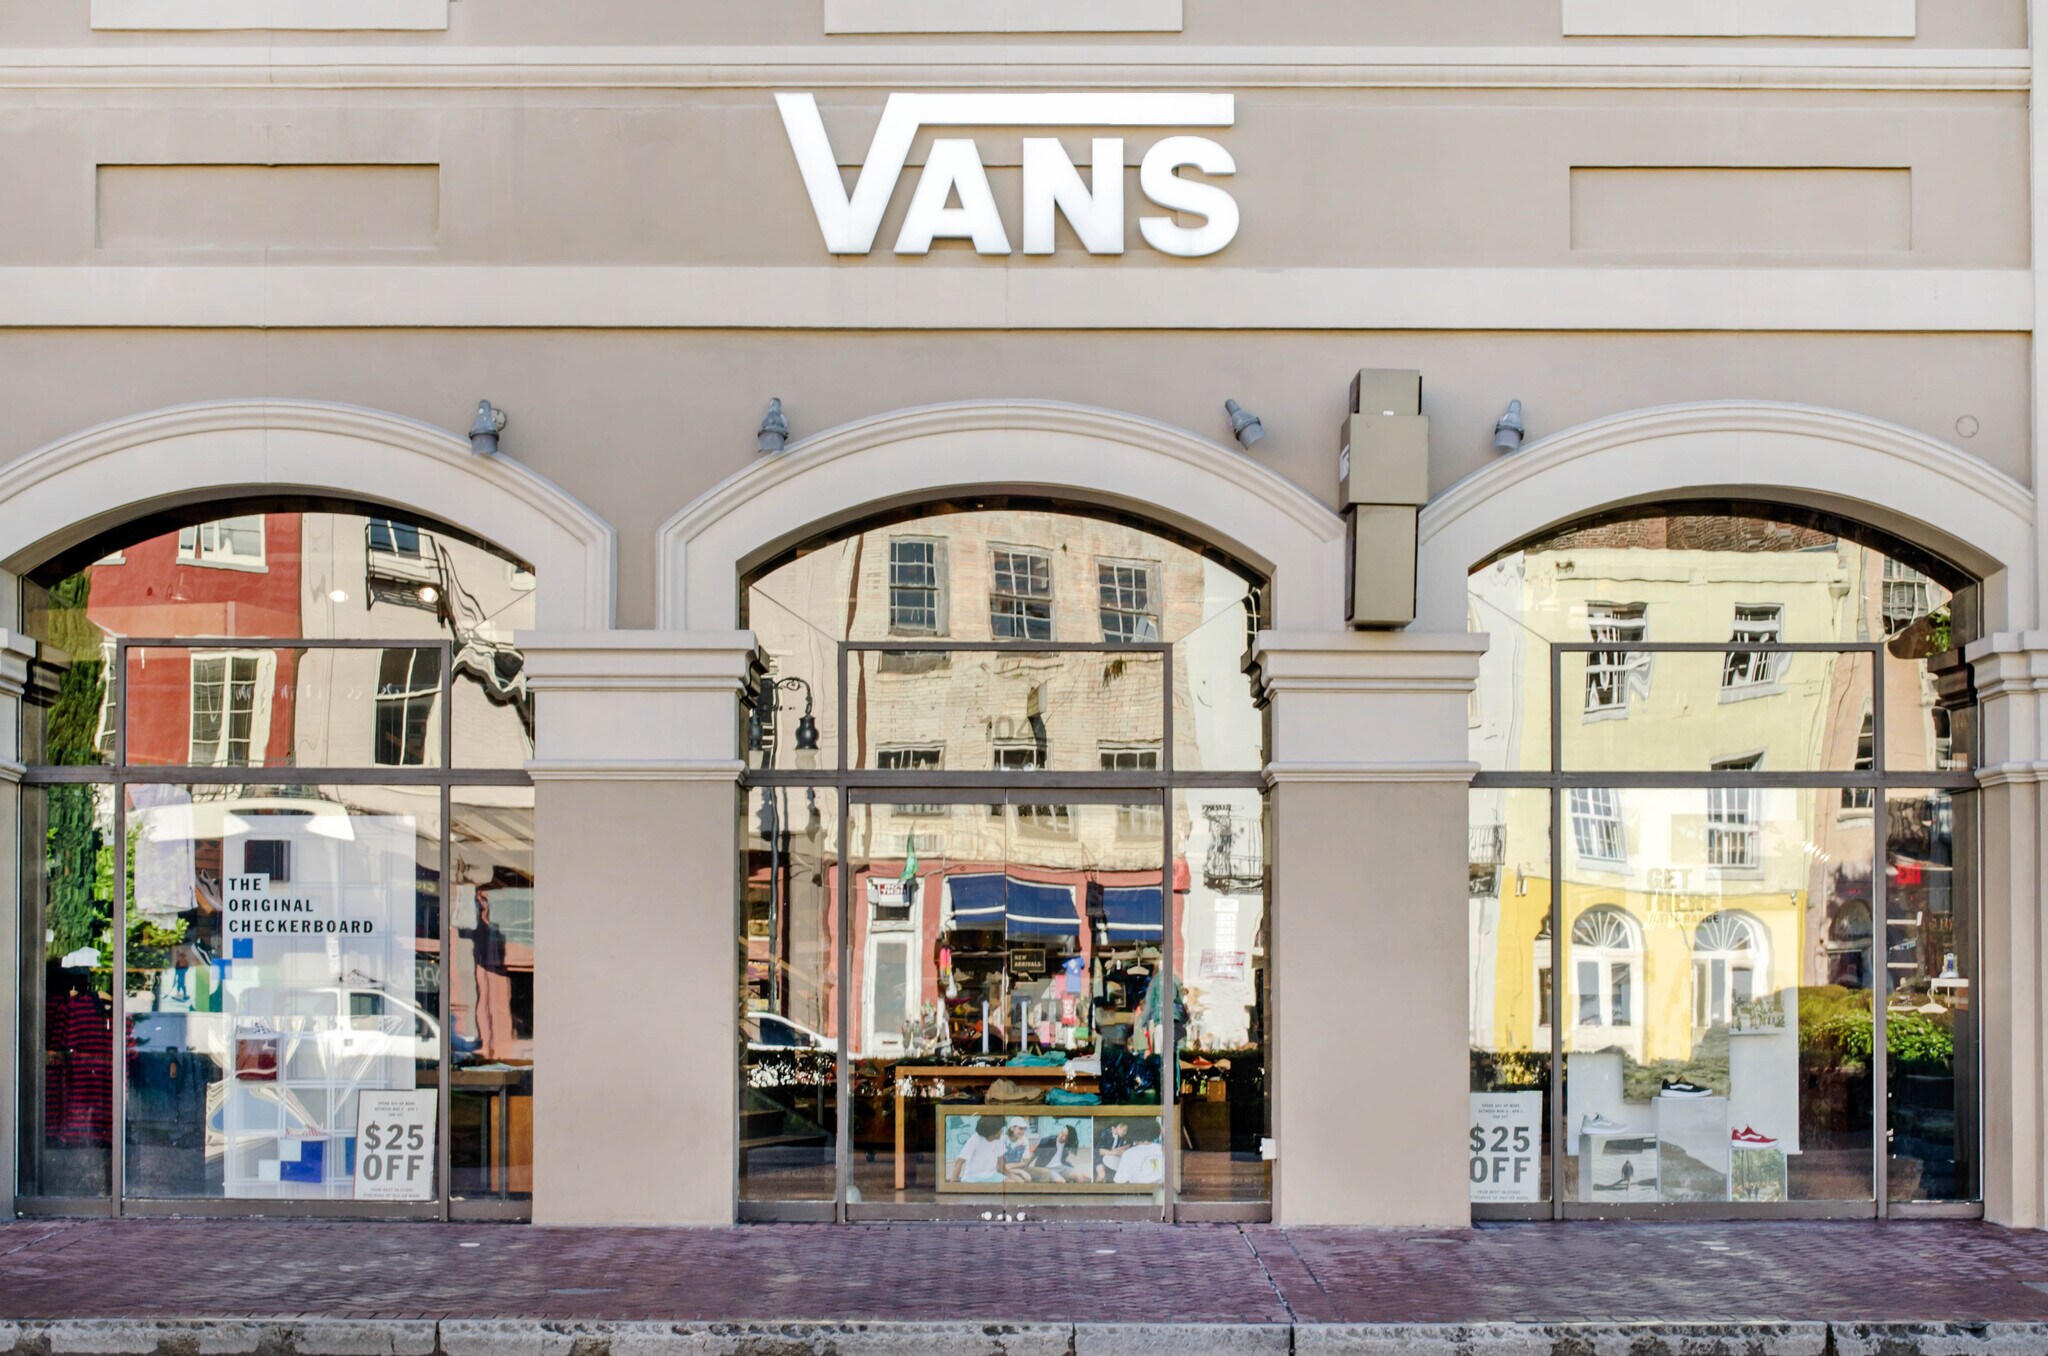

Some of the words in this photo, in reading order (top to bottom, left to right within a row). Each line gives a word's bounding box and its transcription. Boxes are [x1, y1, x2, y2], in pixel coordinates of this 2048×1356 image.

[774, 91, 1241, 258] VANS
[980, 714, 1036, 742] 104
[229, 878, 262, 891] THE
[229, 898, 314, 912] ORIGINAL
[229, 919, 374, 934] CHECKERBOARD
[364, 1120, 424, 1153] $25
[1469, 1122, 1531, 1156] $25
[363, 1153, 424, 1181] OFF
[1469, 1156, 1531, 1183] OFF
